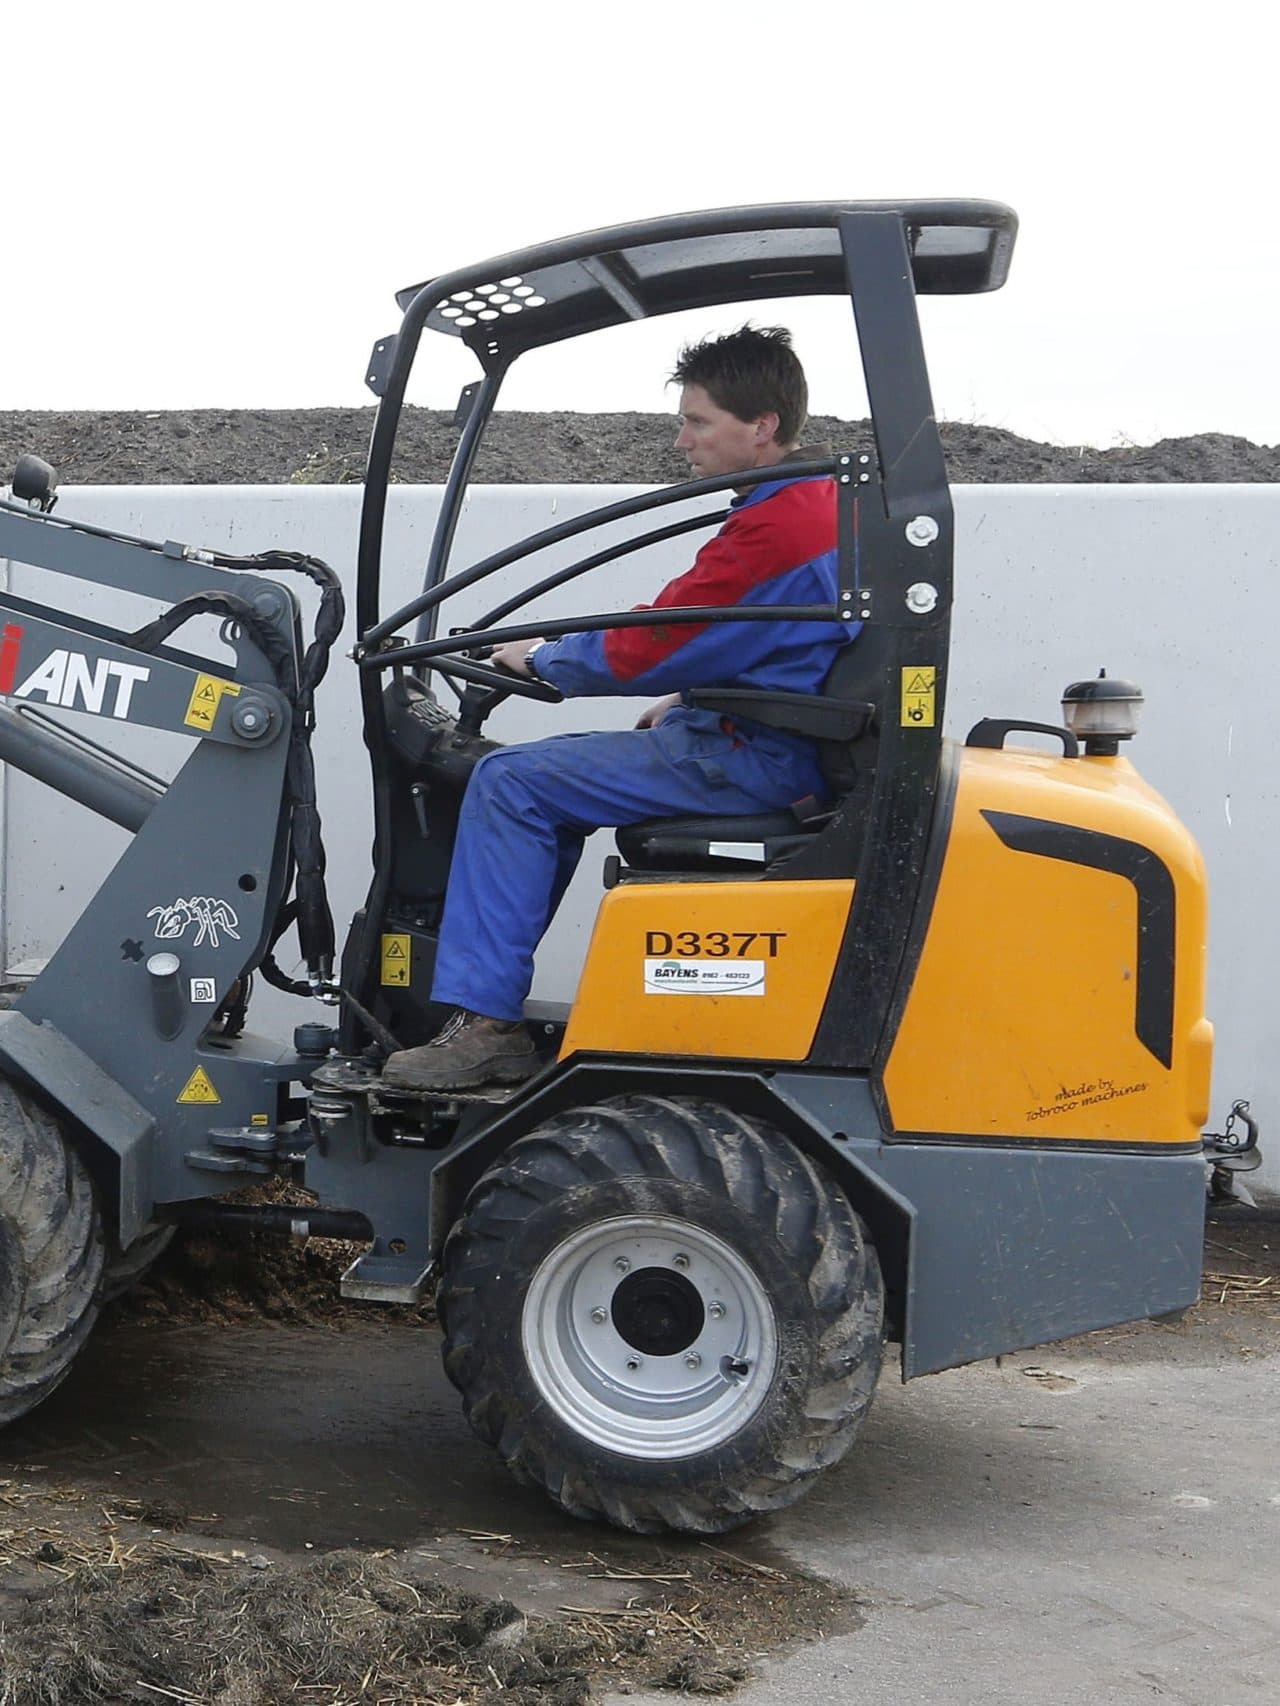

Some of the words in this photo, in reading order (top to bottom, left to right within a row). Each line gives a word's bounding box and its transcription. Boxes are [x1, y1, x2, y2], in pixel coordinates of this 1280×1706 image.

[645, 931, 787, 957] D337T
[654, 968, 699, 978] BAYENS
[1026, 1102, 1079, 1121] Tobroco
[1081, 1082, 1148, 1107] machines
[1055, 1083, 1096, 1101] made
[1098, 1078, 1114, 1090] by
